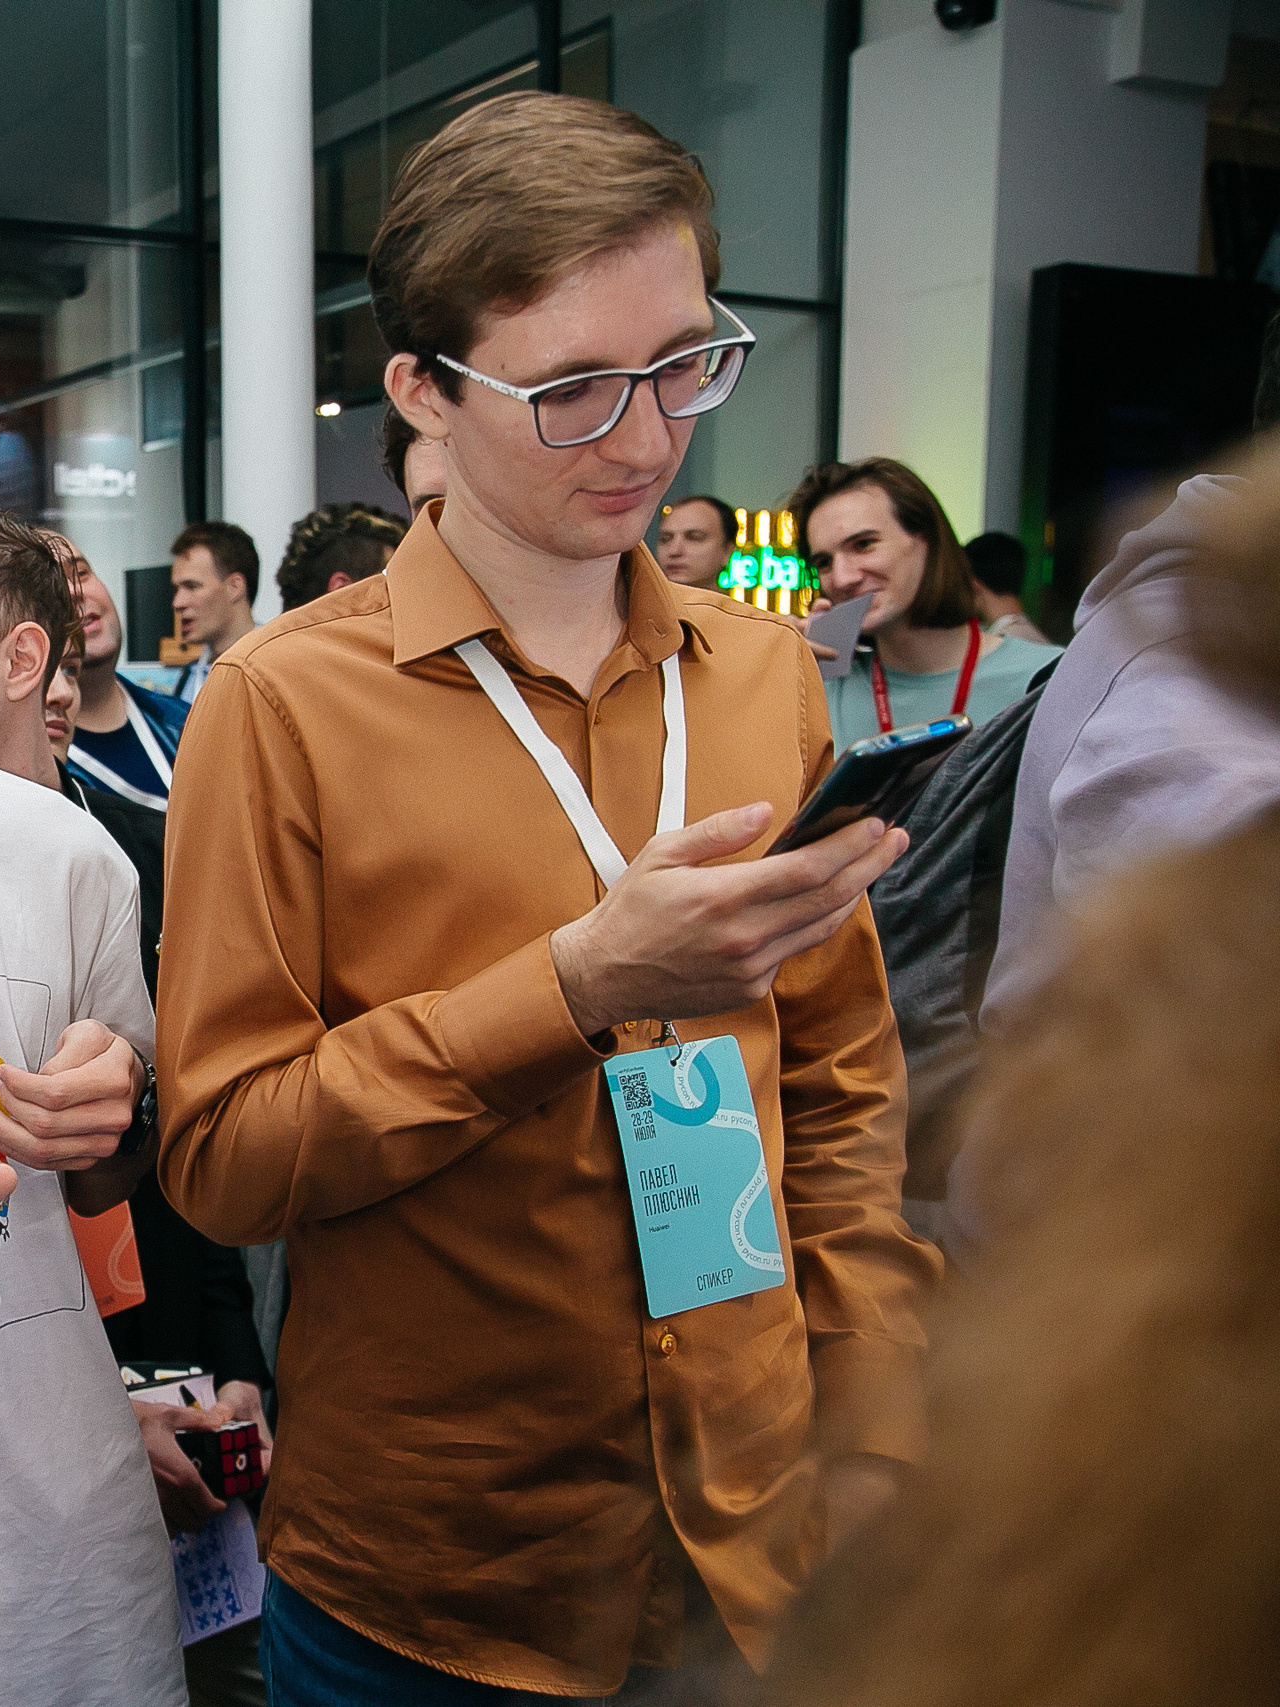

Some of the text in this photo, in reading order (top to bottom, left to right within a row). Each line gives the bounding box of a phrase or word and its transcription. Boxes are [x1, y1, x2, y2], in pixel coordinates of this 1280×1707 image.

[631, 1110, 653, 1127] 28-29
[634, 1124, 657, 1142] ИЮЛЯ
[639, 1163, 678, 1192] ПАВЕЛ
[643, 1184, 701, 1217] ПЛЮСНИН
[740, 1177, 762, 1210] pycon.ru
[734, 1209, 743, 1247] pycon.ru
[742, 1247, 771, 1266] pycon.ru
[696, 1267, 734, 1292] СПИКЕР
